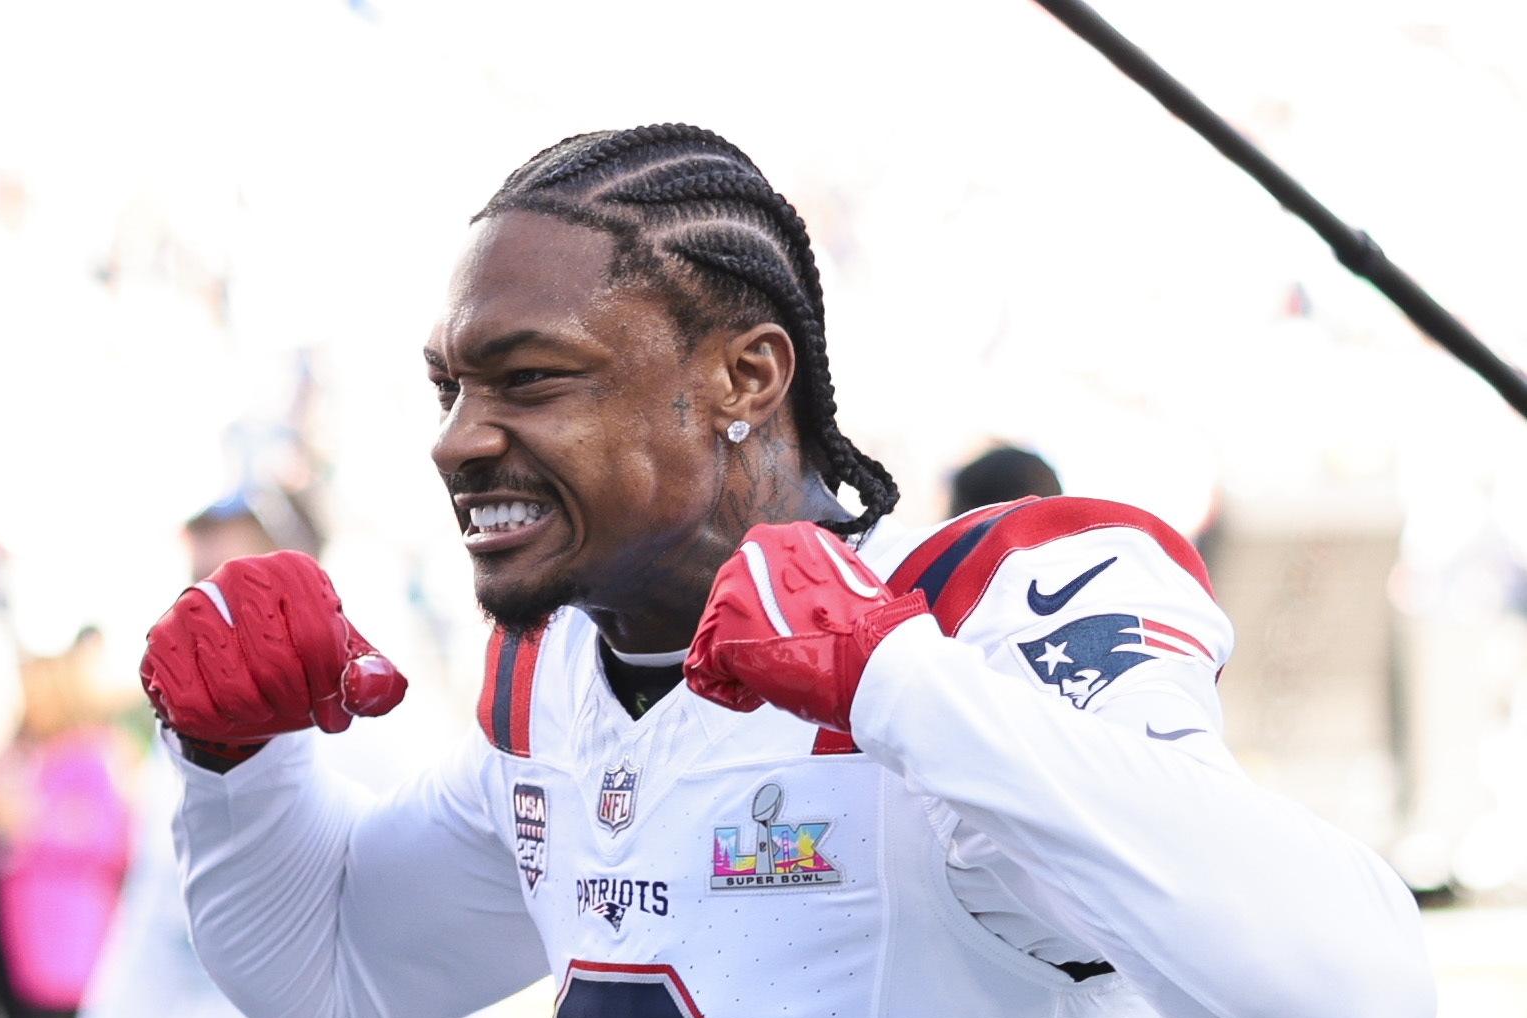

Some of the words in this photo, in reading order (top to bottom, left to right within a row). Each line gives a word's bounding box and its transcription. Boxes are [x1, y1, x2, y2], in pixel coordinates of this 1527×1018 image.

[515, 793, 545, 822] USA
[601, 792, 628, 822] NFL
[726, 876, 775, 886] SUPER
[781, 873, 823, 884] BOWL
[576, 879, 669, 917] PATRIOTS
